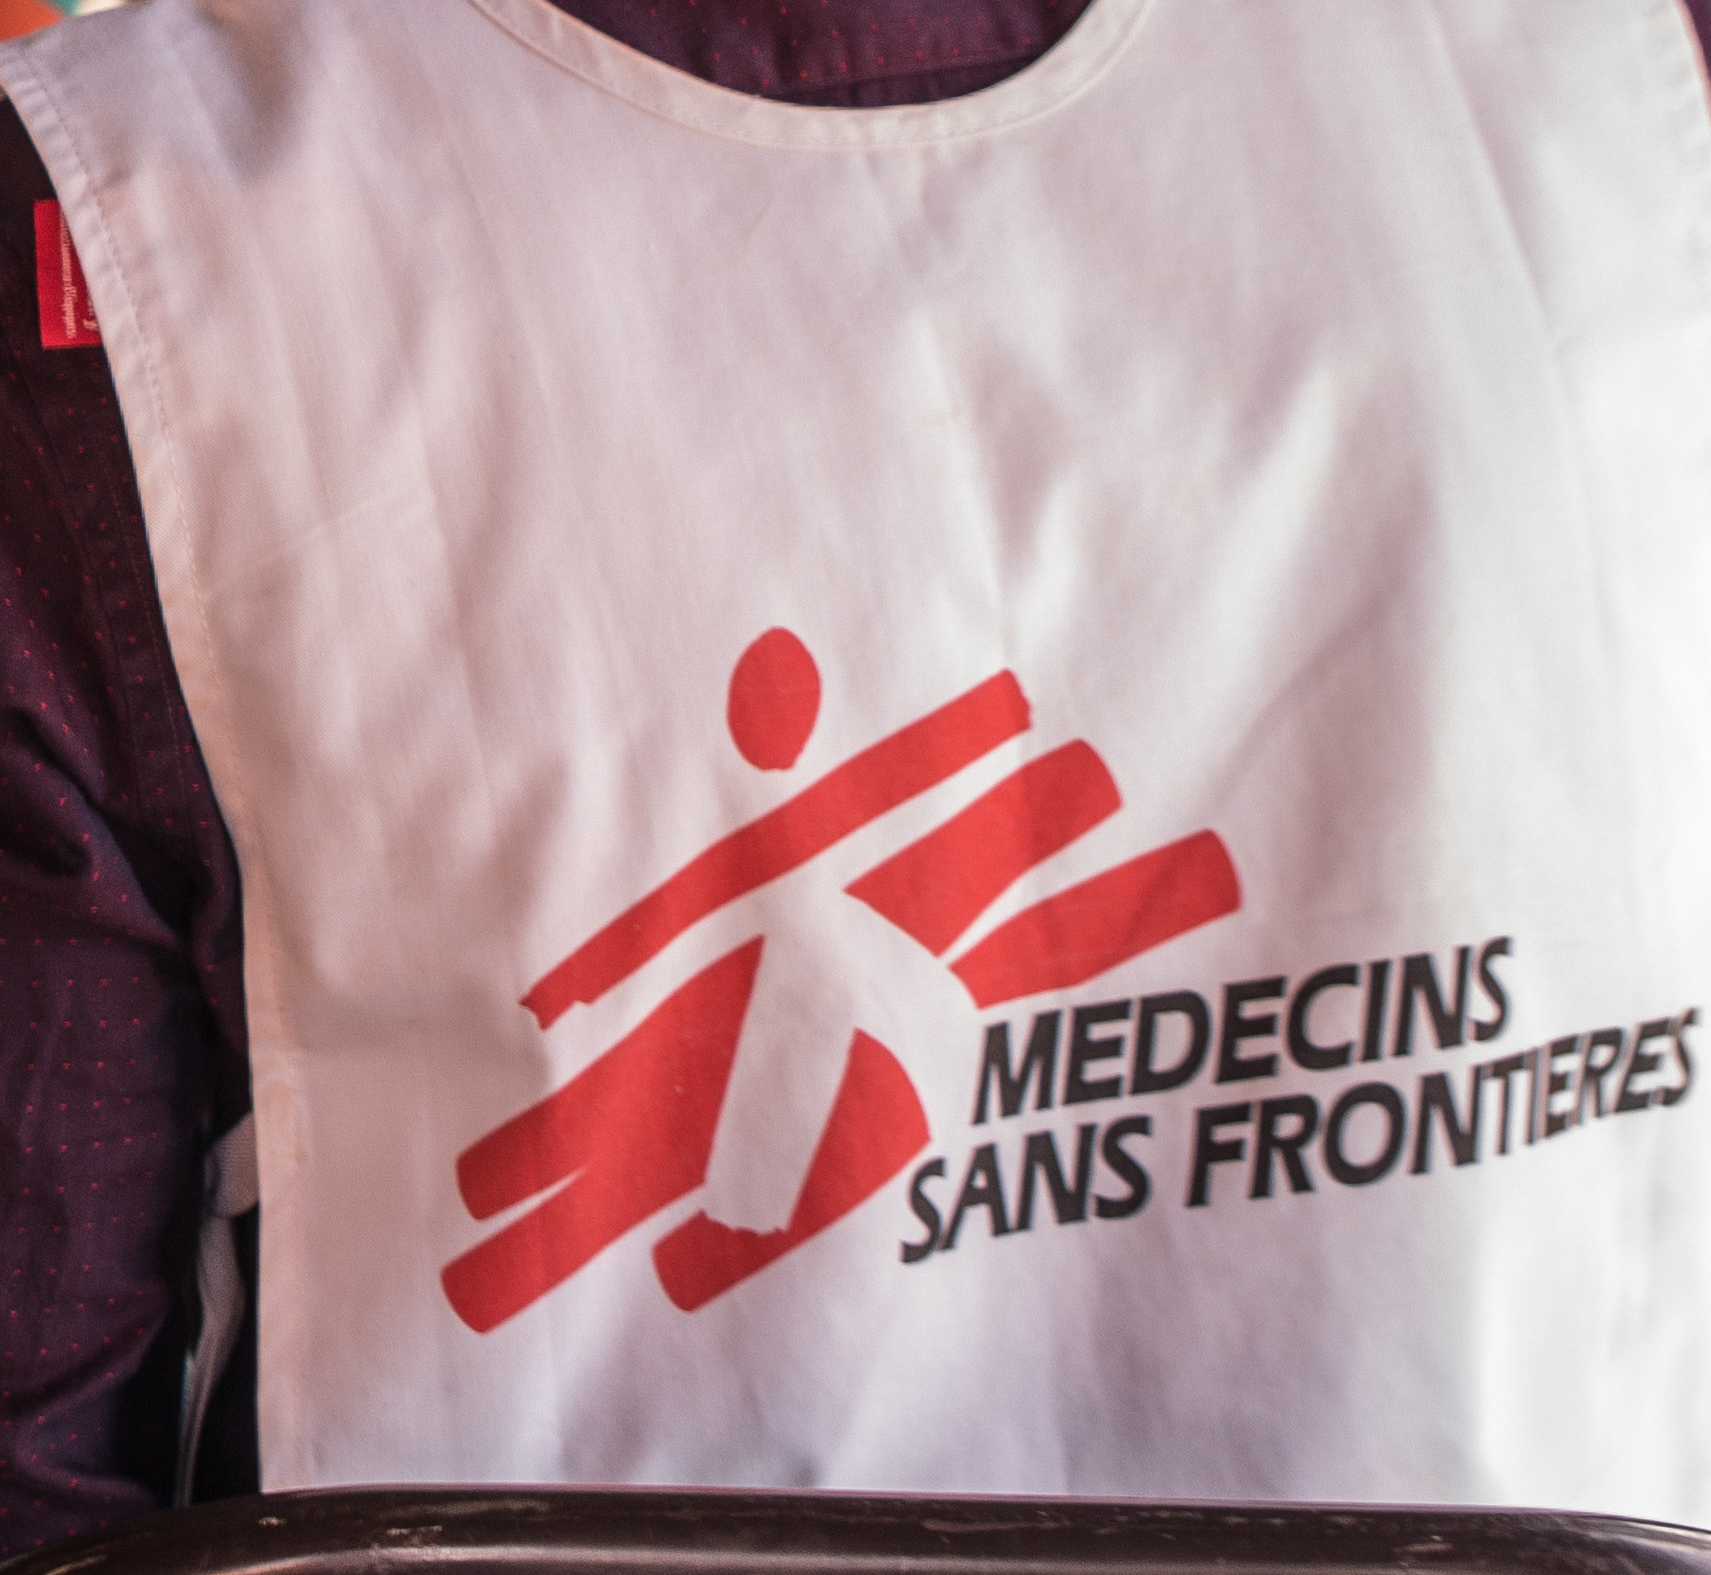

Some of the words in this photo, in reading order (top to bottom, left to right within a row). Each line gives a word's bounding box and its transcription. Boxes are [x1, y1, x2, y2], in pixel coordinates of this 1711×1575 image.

[899, 1114, 1155, 1264] SANS
[1183, 1005, 1703, 1208] FRONTIERES
[970, 934, 1513, 1127] MEDECINS
